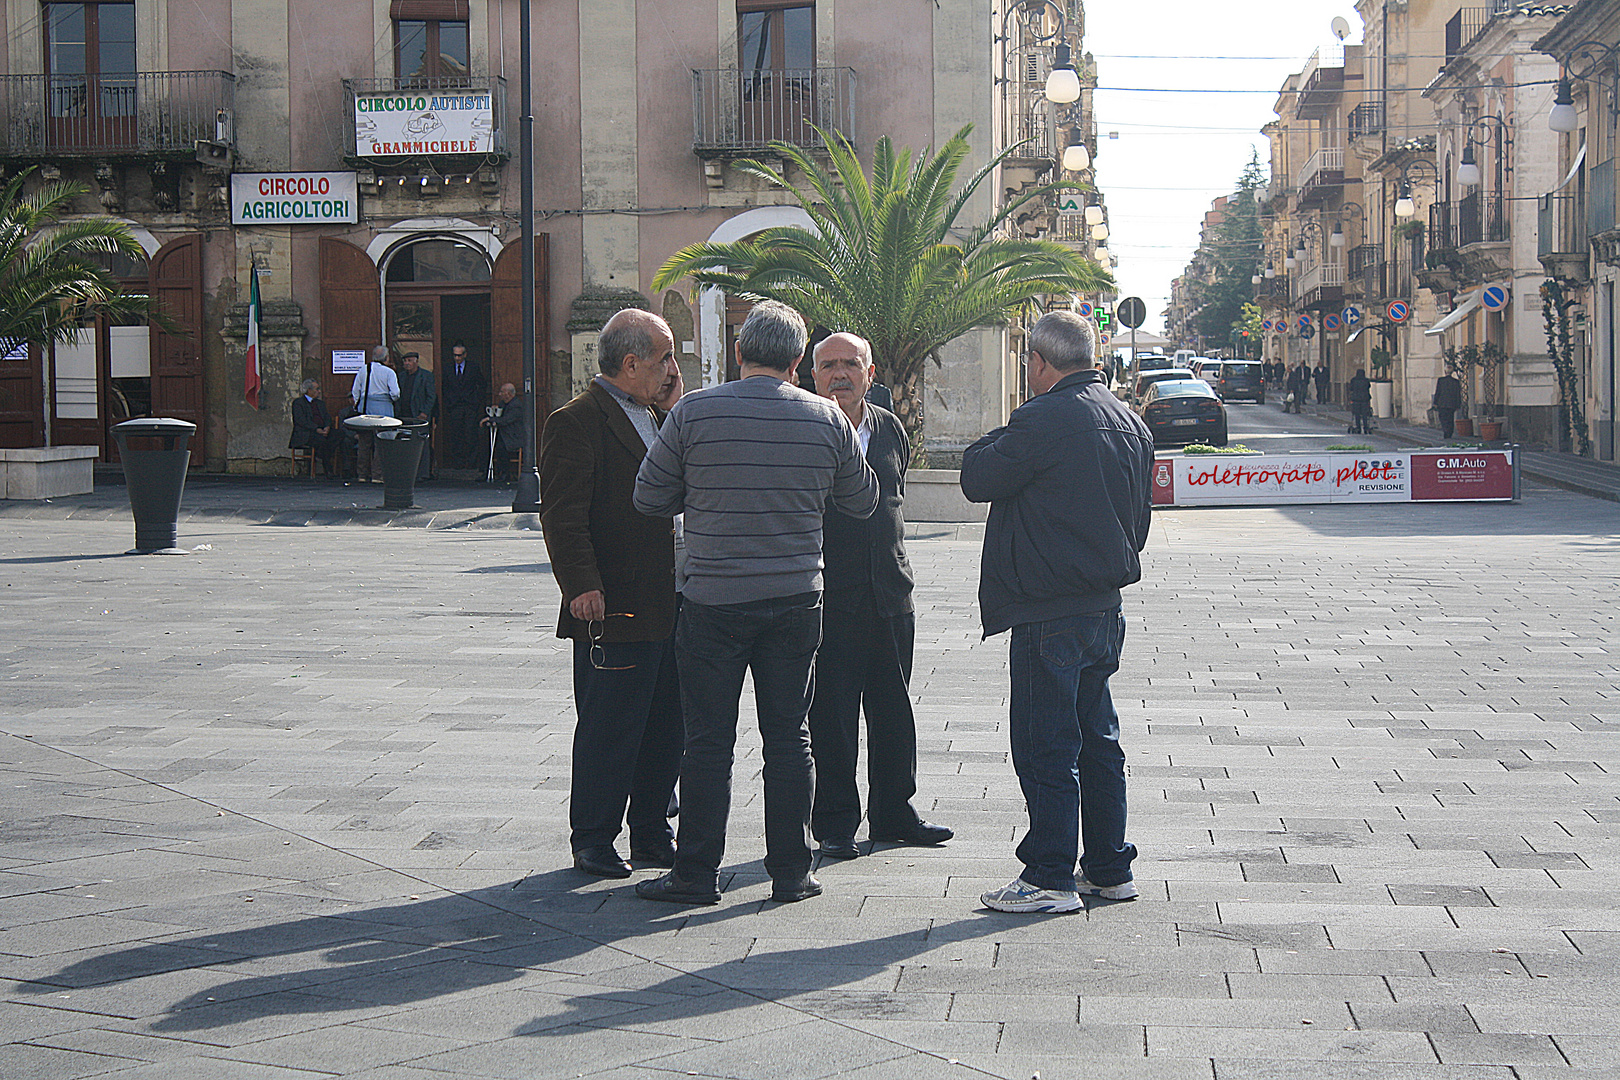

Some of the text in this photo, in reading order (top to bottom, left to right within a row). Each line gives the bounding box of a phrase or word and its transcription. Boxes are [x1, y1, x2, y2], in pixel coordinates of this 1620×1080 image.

[357, 95, 490, 112] CIRCOLO AUTISTI
[372, 140, 477, 154] GRAMMICHELE
[258, 177, 330, 196] CIRCOLO
[241, 200, 349, 219] AGRICOLTORI
[1358, 483, 1405, 491] REVISIONE
